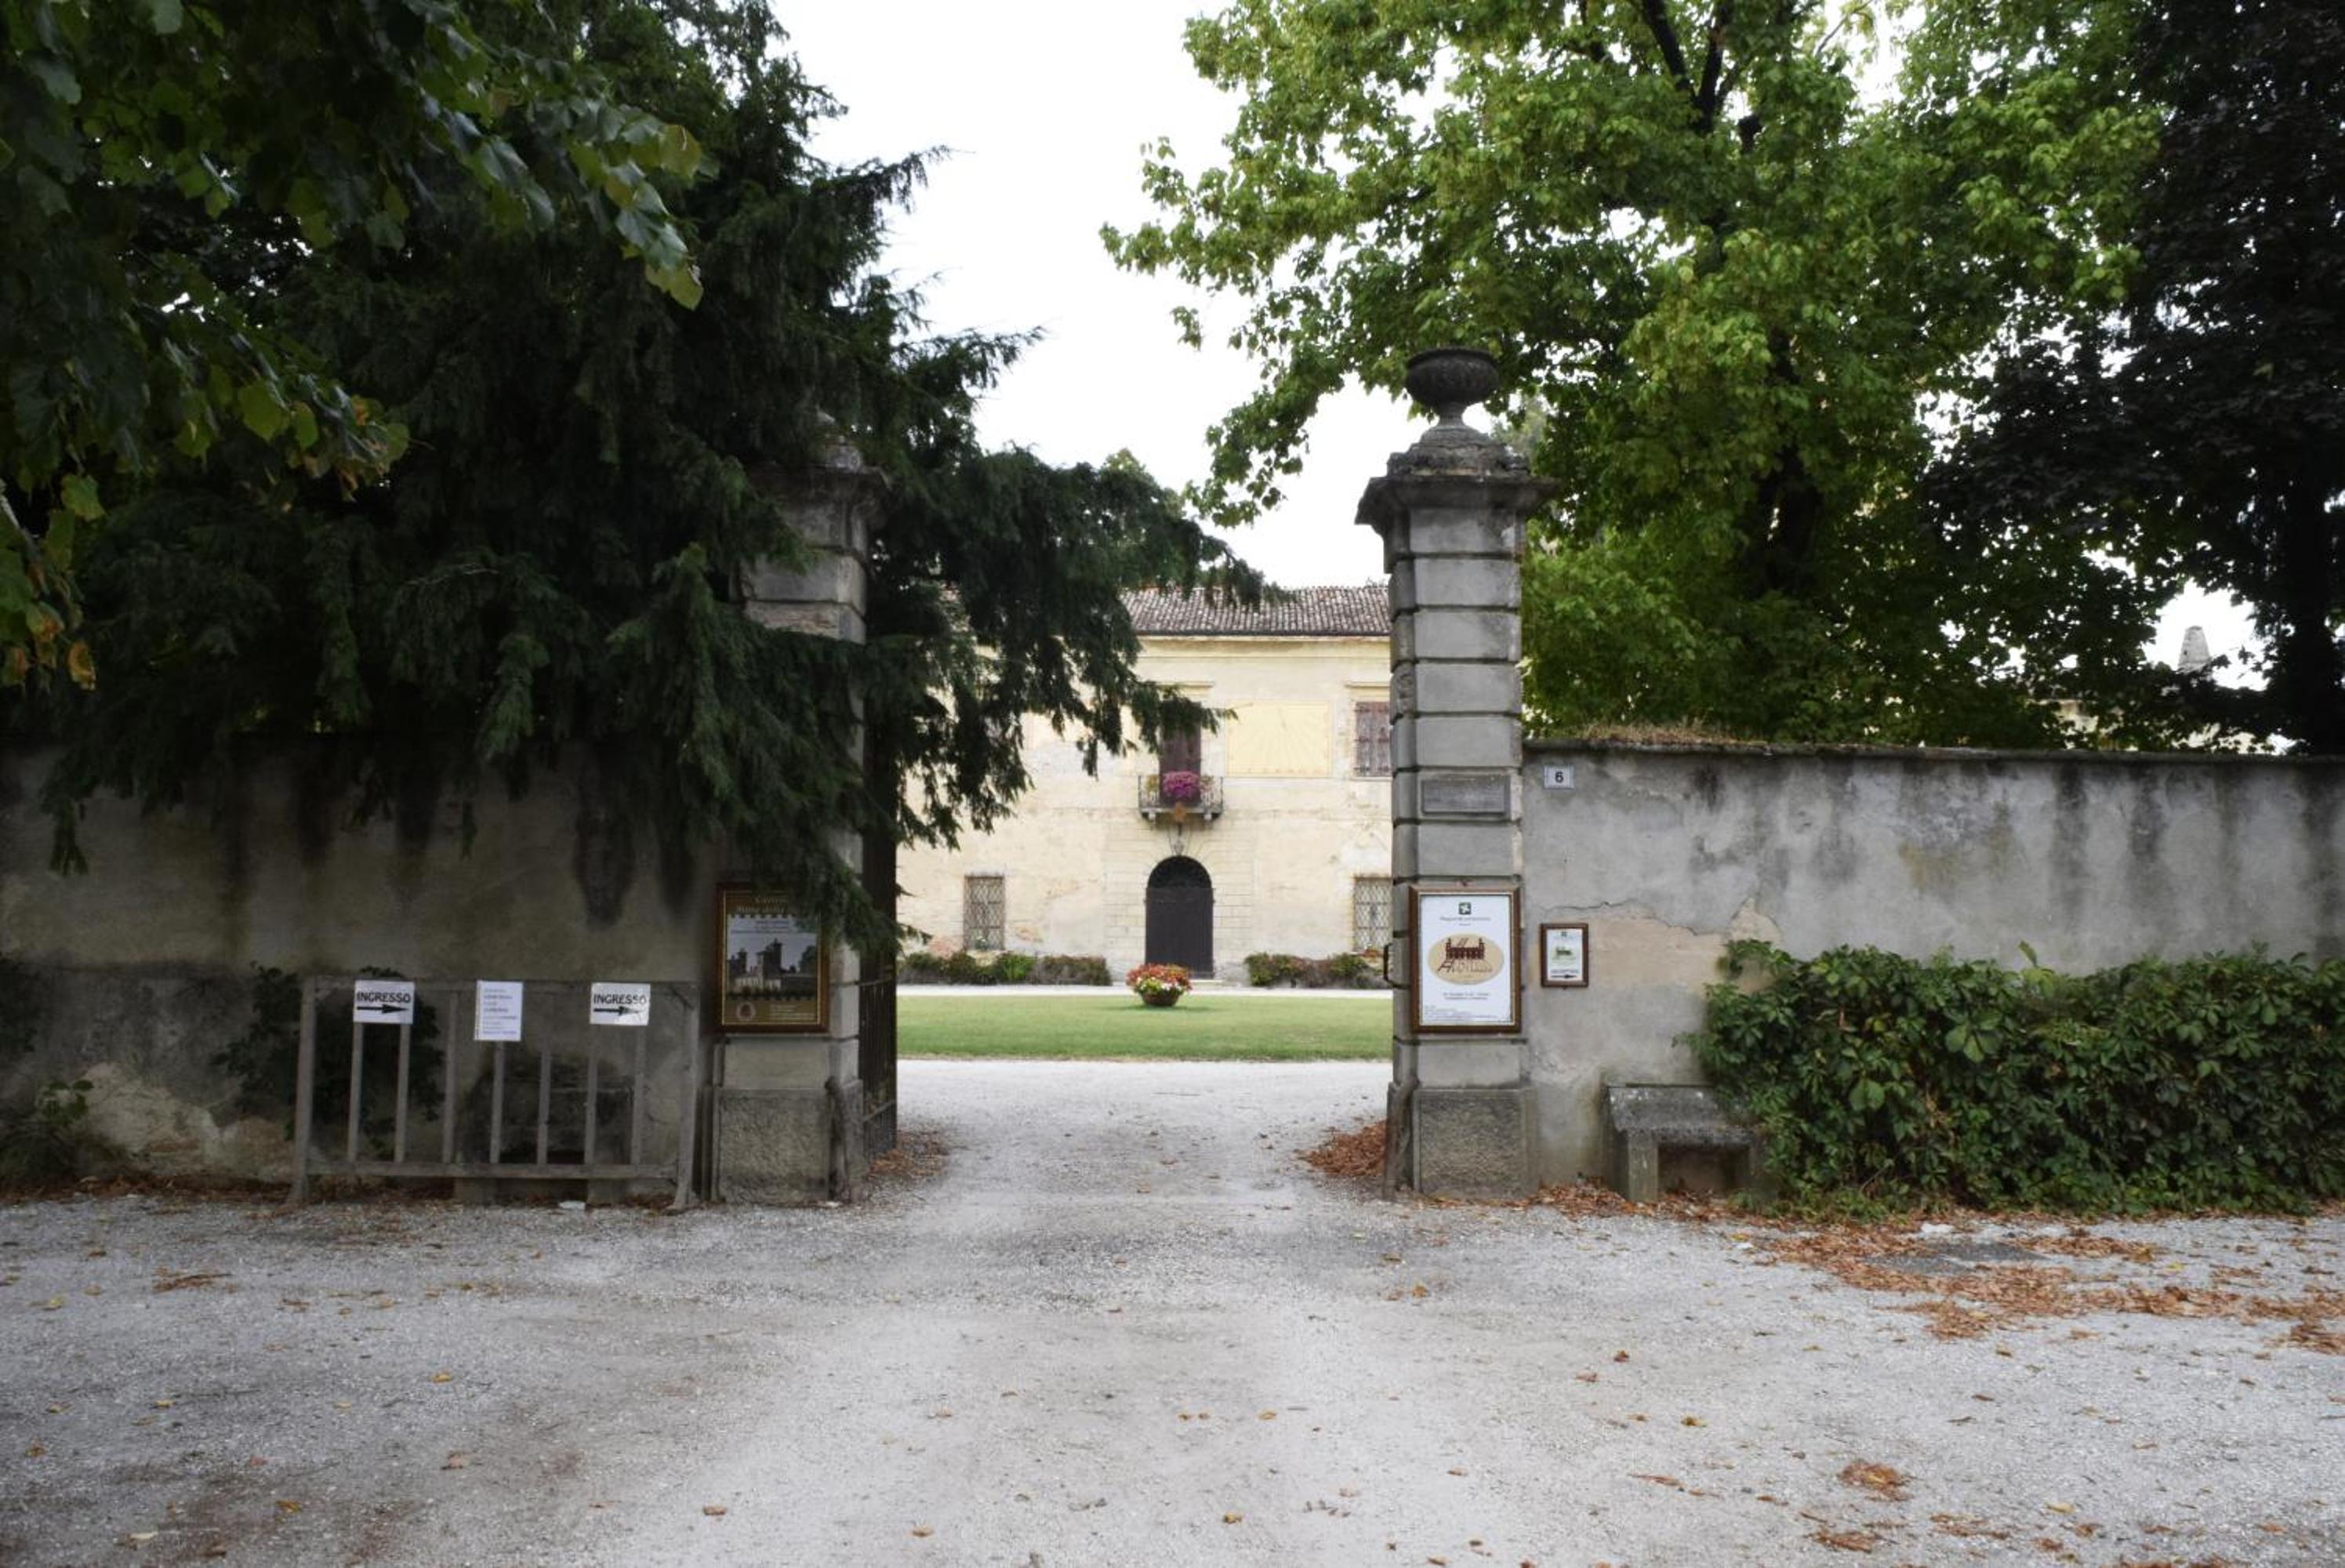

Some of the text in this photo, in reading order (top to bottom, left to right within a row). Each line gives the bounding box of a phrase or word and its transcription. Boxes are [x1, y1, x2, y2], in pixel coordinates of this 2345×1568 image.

[1555, 771, 1564, 783] 6
[357, 991, 411, 1003] INGRESSO
[594, 993, 647, 1004] INGRESSO
